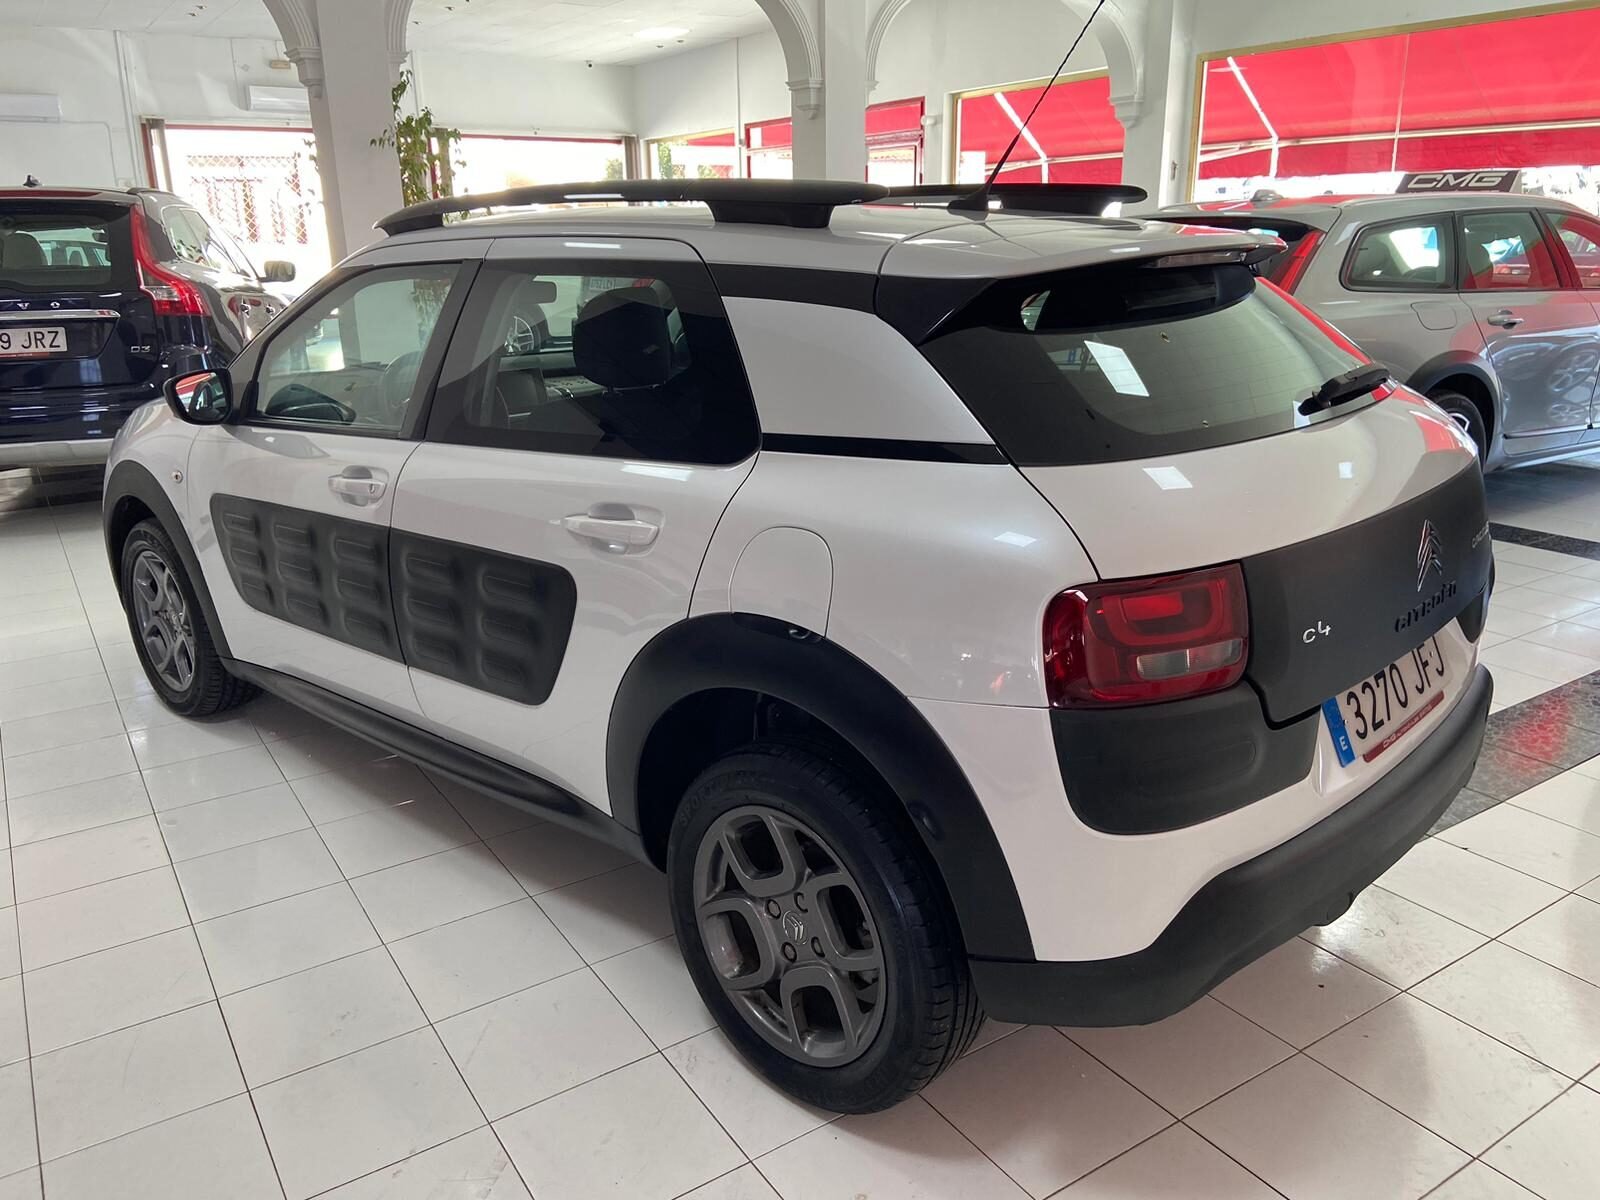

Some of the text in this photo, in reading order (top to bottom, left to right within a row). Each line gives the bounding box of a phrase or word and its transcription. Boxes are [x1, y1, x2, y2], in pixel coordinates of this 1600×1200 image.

[1407, 172, 1508, 188] CMG
[21, 330, 61, 349] JRZ
[1303, 620, 1331, 643] C4
[1346, 663, 1408, 739] 3270
[1412, 635, 1445, 694] JFJ
